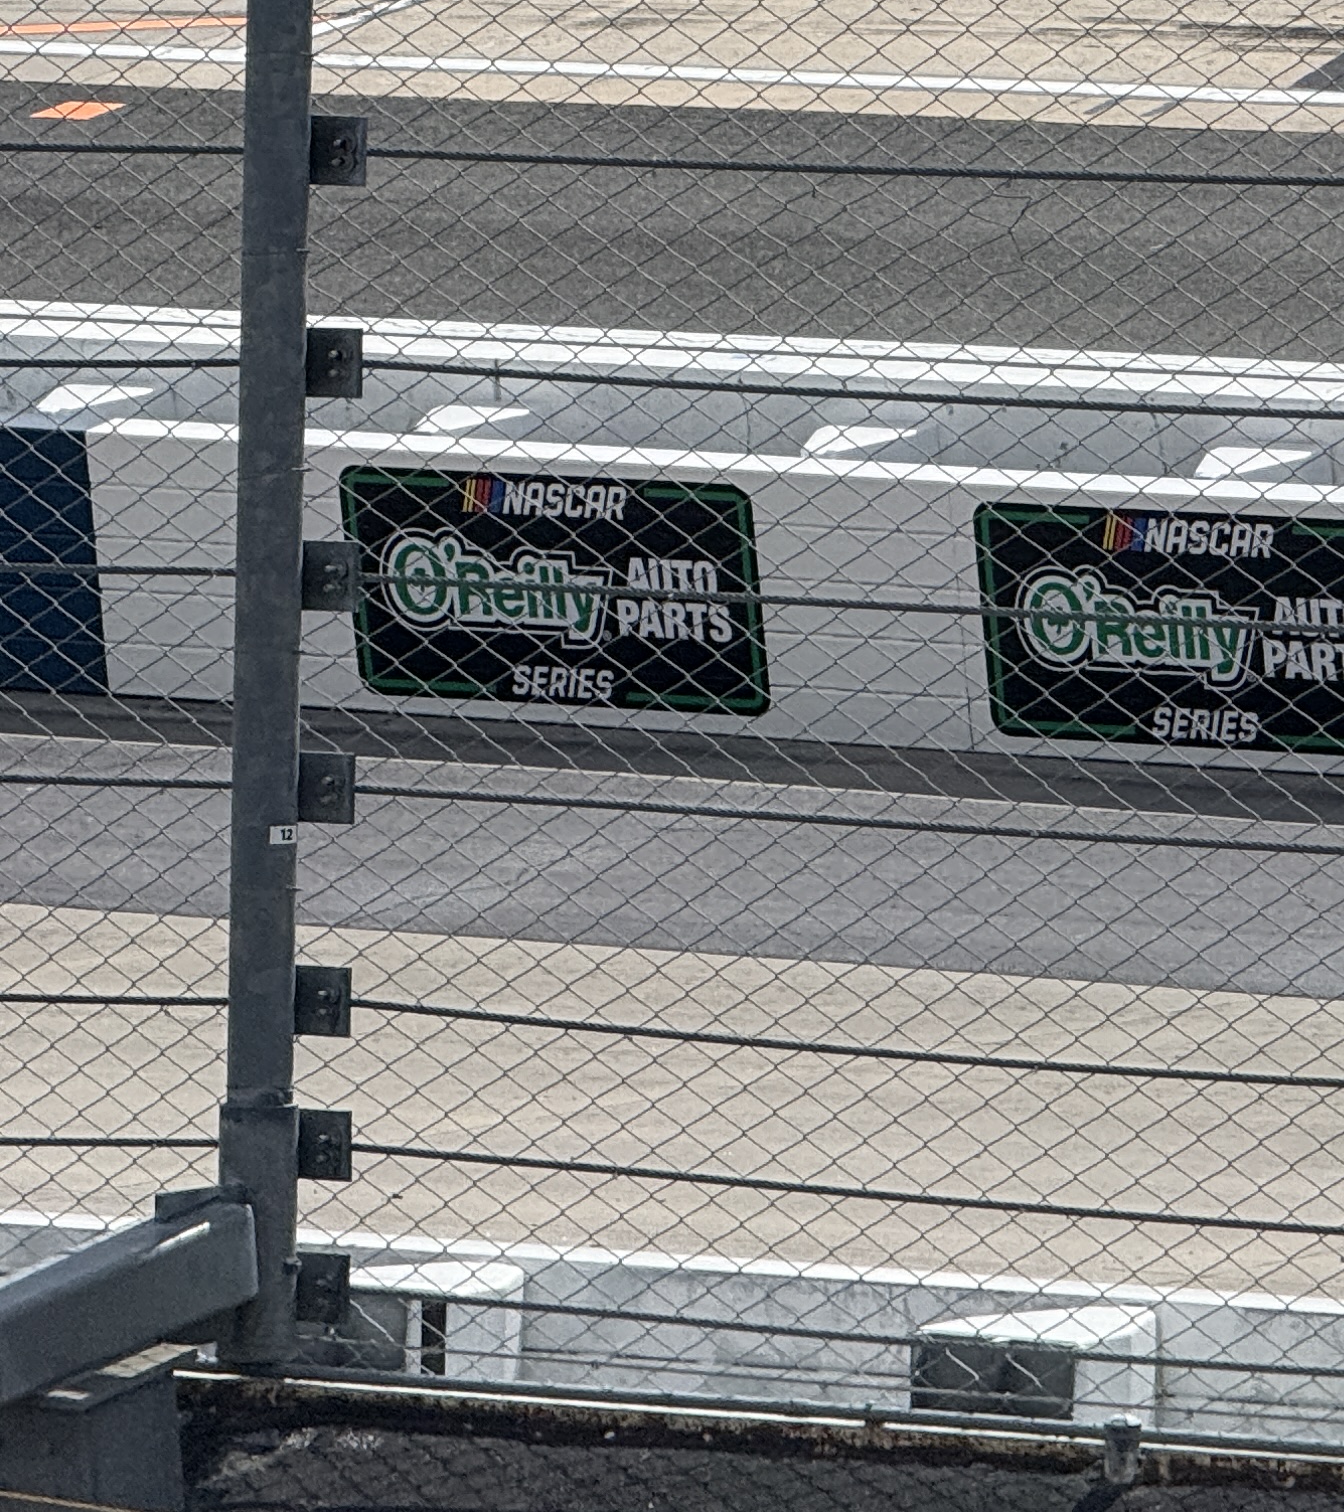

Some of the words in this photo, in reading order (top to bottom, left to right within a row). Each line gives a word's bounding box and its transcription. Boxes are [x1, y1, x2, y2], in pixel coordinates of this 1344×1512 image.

[503, 480, 626, 521] NASCAR
[1145, 517, 1275, 558] NASCAR
[390, 536, 605, 638] O'Reilly
[626, 556, 717, 595] AUTO
[617, 597, 732, 643] PARTS
[1026, 574, 1248, 680] O'Reilly
[512, 663, 614, 700] SERIES
[1153, 706, 1260, 743] SERIES
[280, 828, 293, 841] 12
